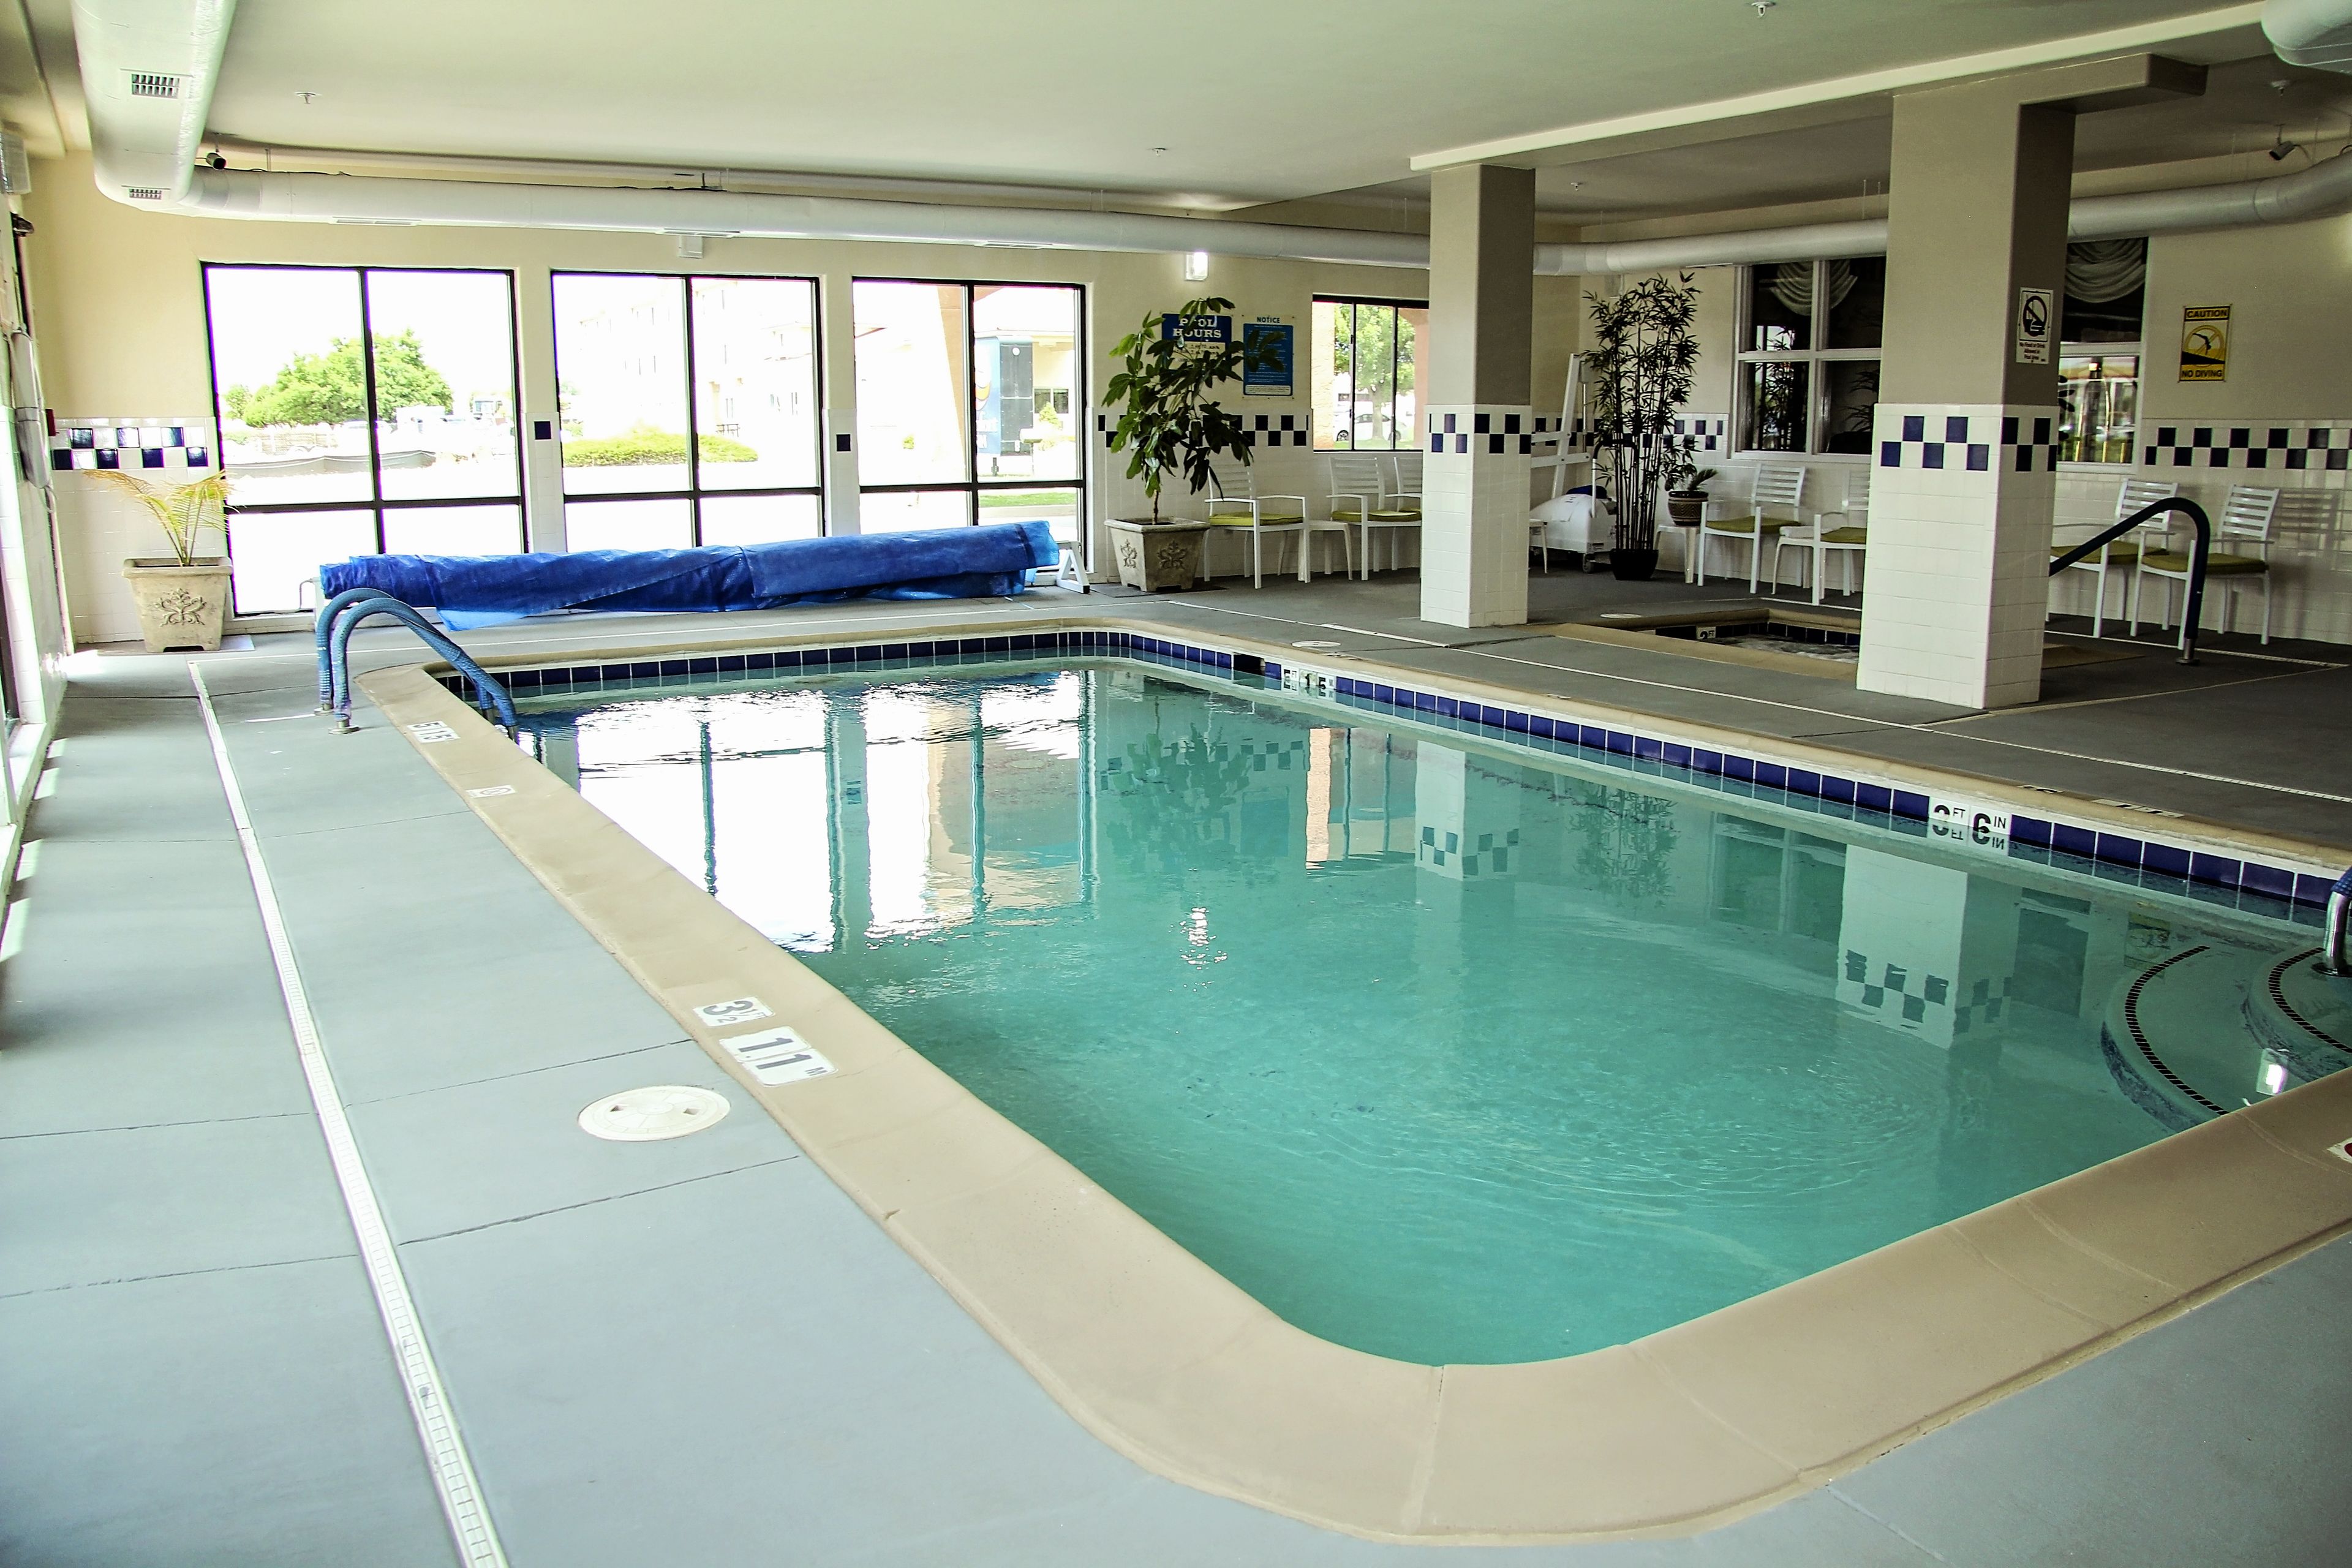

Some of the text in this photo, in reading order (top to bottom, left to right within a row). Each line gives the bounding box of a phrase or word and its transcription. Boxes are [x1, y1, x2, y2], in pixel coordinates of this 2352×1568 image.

[2187, 309, 2228, 318] CAUTION
[1178, 318, 1216, 327] POL
[1953, 807, 1966, 818] FT
[1994, 816, 2007, 829] IN
[805, 1066, 827, 1076] M
